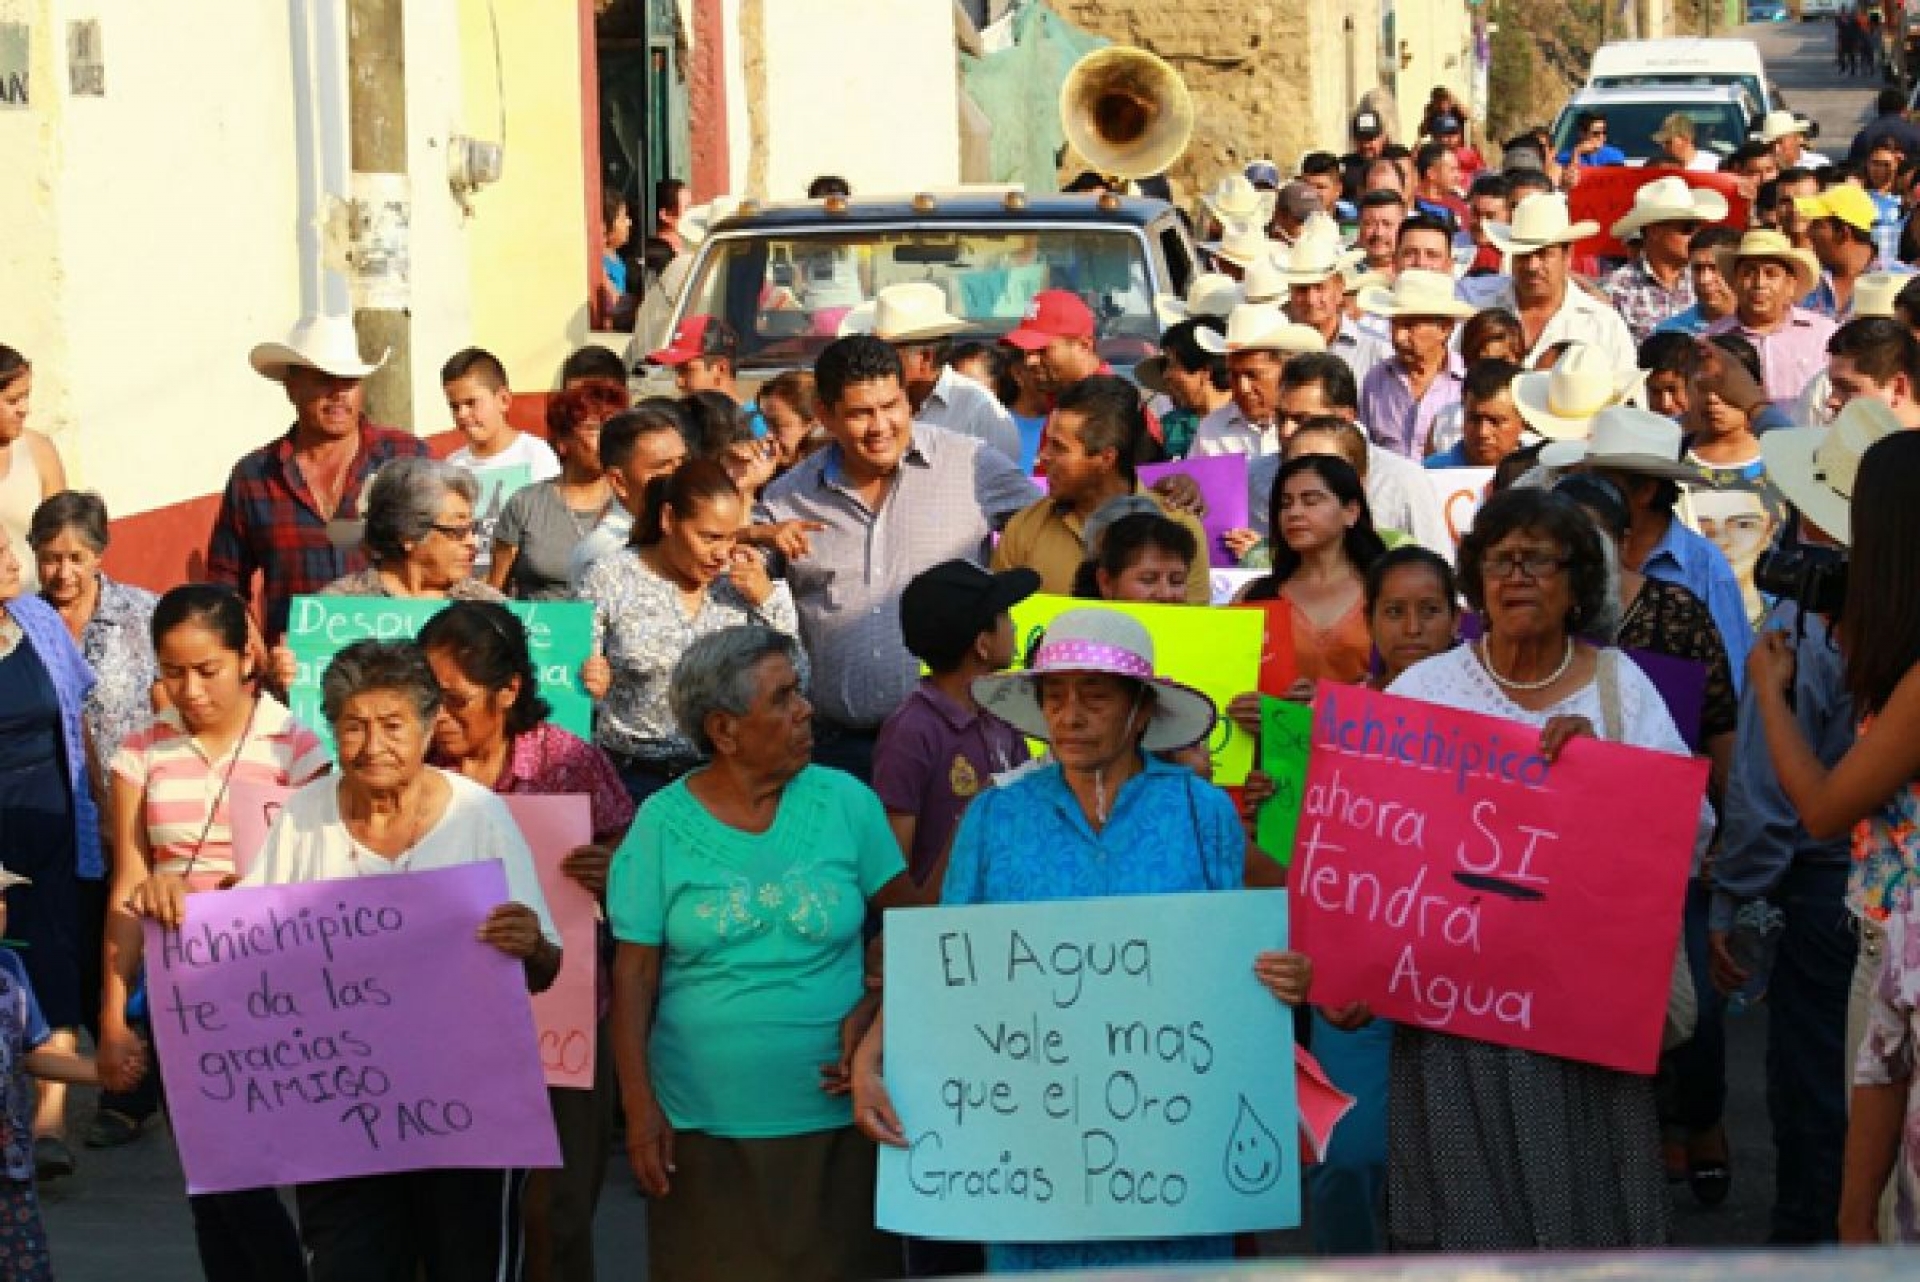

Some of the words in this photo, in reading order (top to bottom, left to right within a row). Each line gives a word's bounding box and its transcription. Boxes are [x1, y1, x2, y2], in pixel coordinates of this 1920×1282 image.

[1318, 690, 1551, 794] Achichipico
[1305, 769, 1427, 850] ahora
[1456, 799, 1559, 885] SI
[162, 901, 403, 970] Achichipico
[939, 932, 978, 987] El
[1007, 929, 1152, 1009] Agua
[166, 984, 227, 1035] te
[247, 971, 300, 1019] da
[322, 967, 392, 1010] las
[1388, 944, 1534, 1029] Agua
[199, 1028, 372, 1101] gracias
[1106, 1020, 1214, 1075] mas
[246, 1064, 390, 1113] AMIGO
[338, 1098, 473, 1150] PACO
[941, 1076, 1019, 1127] que
[1042, 1075, 1080, 1126] el
[1105, 1070, 1192, 1125] Oro
[908, 1130, 1054, 1203] Gracias
[1081, 1128, 1188, 1206] Paco
